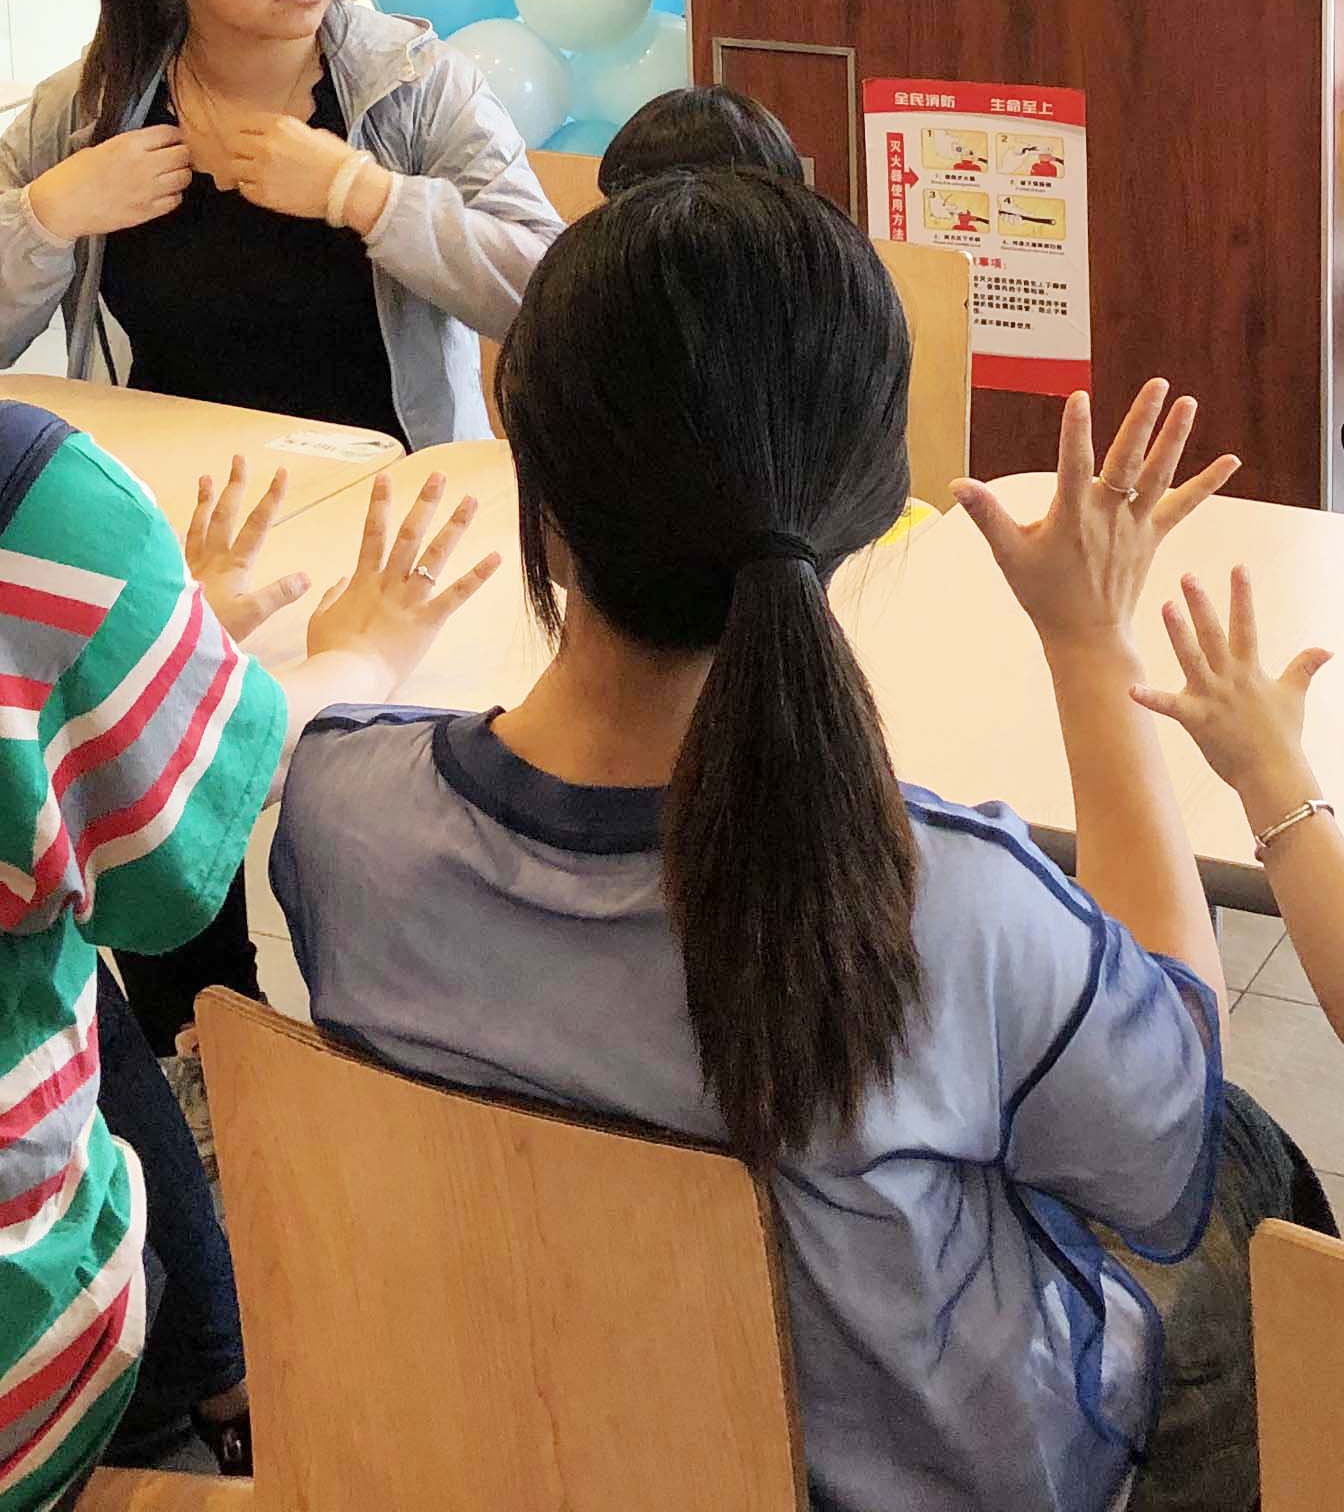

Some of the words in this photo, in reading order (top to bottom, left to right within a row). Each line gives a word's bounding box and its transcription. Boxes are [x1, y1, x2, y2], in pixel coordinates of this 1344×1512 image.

[894, 91, 956, 108] 全民消防
[990, 98, 1054, 115] 生命至上
[889, 140, 905, 240] 灭火器使用方法
